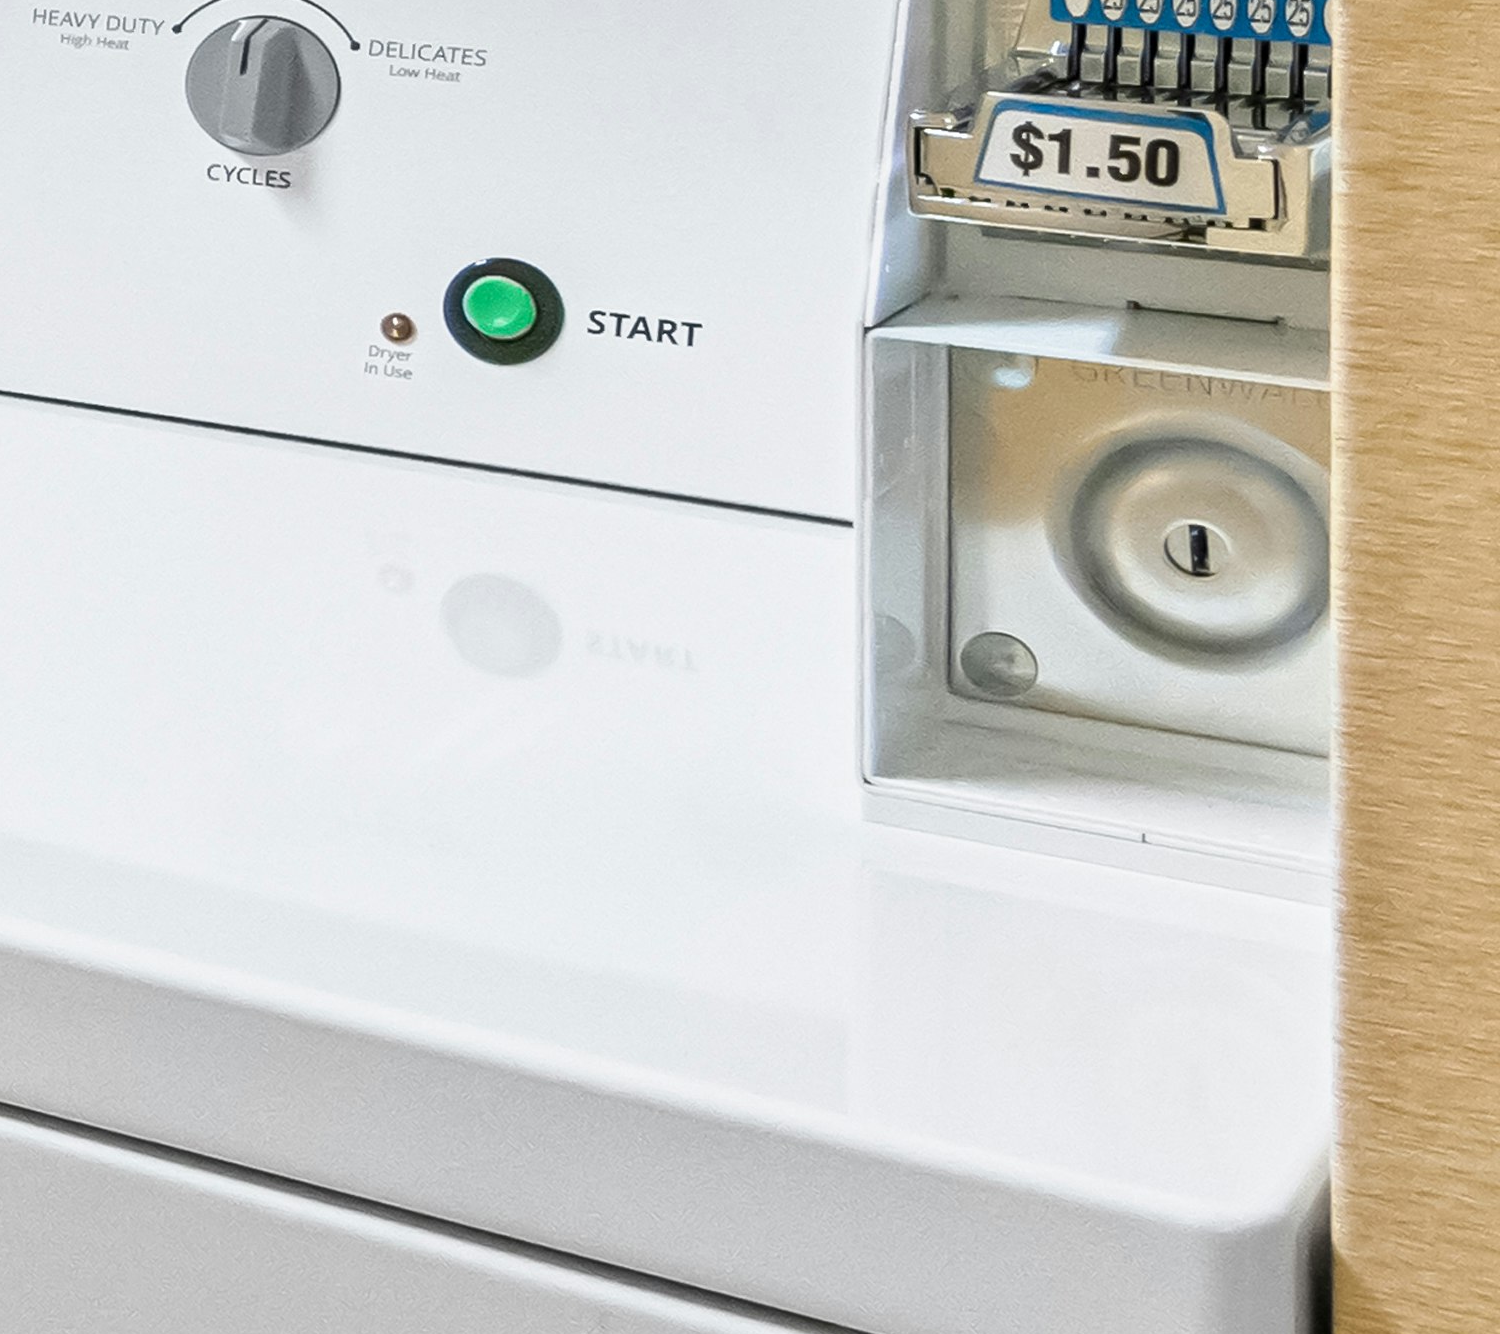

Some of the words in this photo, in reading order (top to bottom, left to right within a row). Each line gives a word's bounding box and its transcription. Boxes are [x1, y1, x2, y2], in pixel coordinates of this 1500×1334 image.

[33, 8, 101, 29] HEAVY
[106, 15, 165, 36] DUTY
[60, 33, 93, 49] High
[96, 37, 129, 51] Heat
[368, 39, 488, 67] DELICATES
[389, 64, 420, 78] Low
[425, 68, 461, 82] Heat
[1009, 121, 1180, 188] $1.50
[206, 163, 292, 190] CYCLES
[587, 310, 703, 347] START
[368, 344, 413, 364] Dryer
[364, 362, 379, 376] In
[384, 364, 414, 381] Use
